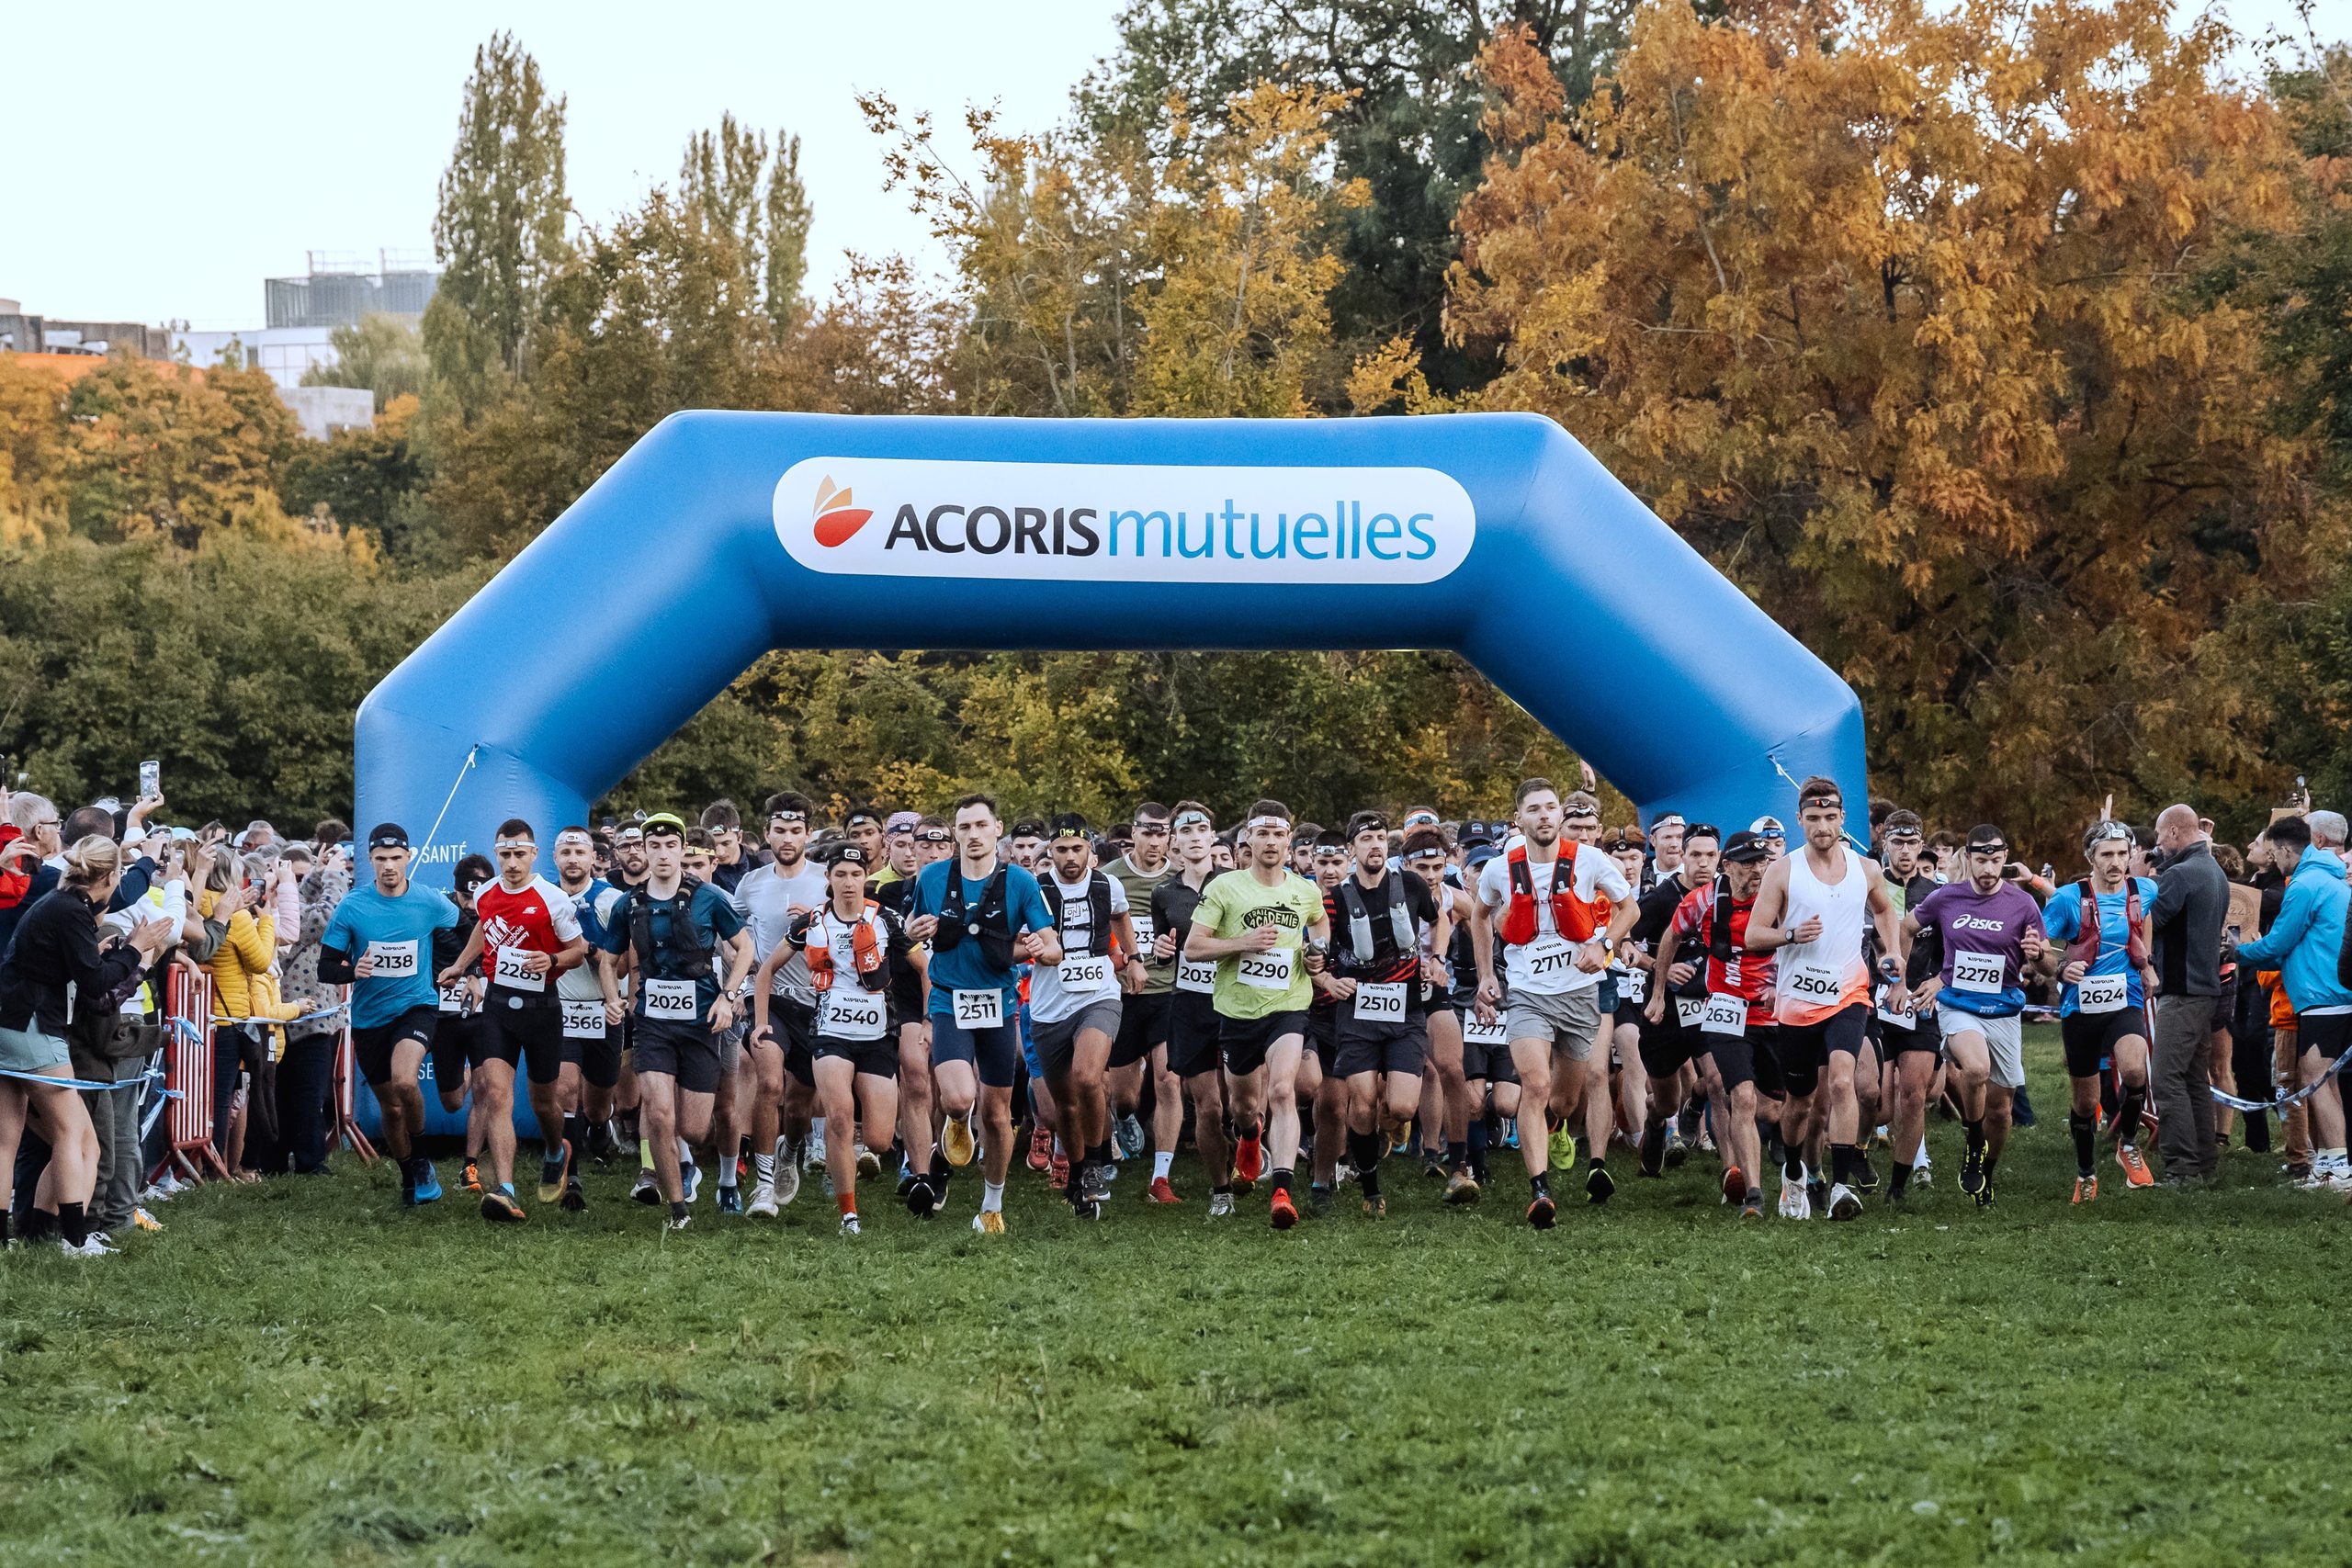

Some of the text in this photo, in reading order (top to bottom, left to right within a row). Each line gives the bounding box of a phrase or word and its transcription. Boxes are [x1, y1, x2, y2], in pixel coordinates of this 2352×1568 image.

[884, 498, 1438, 560] ACORIS mutuelles
[422, 840, 467, 863] SANTÉ
[1248, 908, 1268, 919] TRAIL
[1968, 918, 2005, 931] asics
[1535, 942, 1562, 952] KIPRUN
[374, 954, 413, 969] 2138
[1240, 959, 1289, 980] 2290
[1531, 951, 1572, 974] 2717
[1061, 965, 1103, 983] 2366
[1956, 965, 2000, 984] 2278
[1792, 974, 1840, 996] 2504
[648, 993, 694, 1010] 2026
[1360, 995, 1401, 1012] 2510
[2081, 987, 2124, 1004] 2624
[830, 1007, 879, 1025] 2540
[958, 1002, 997, 1021] 2511
[1705, 1007, 1741, 1026] 2631
[562, 1015, 603, 1030] 2566
